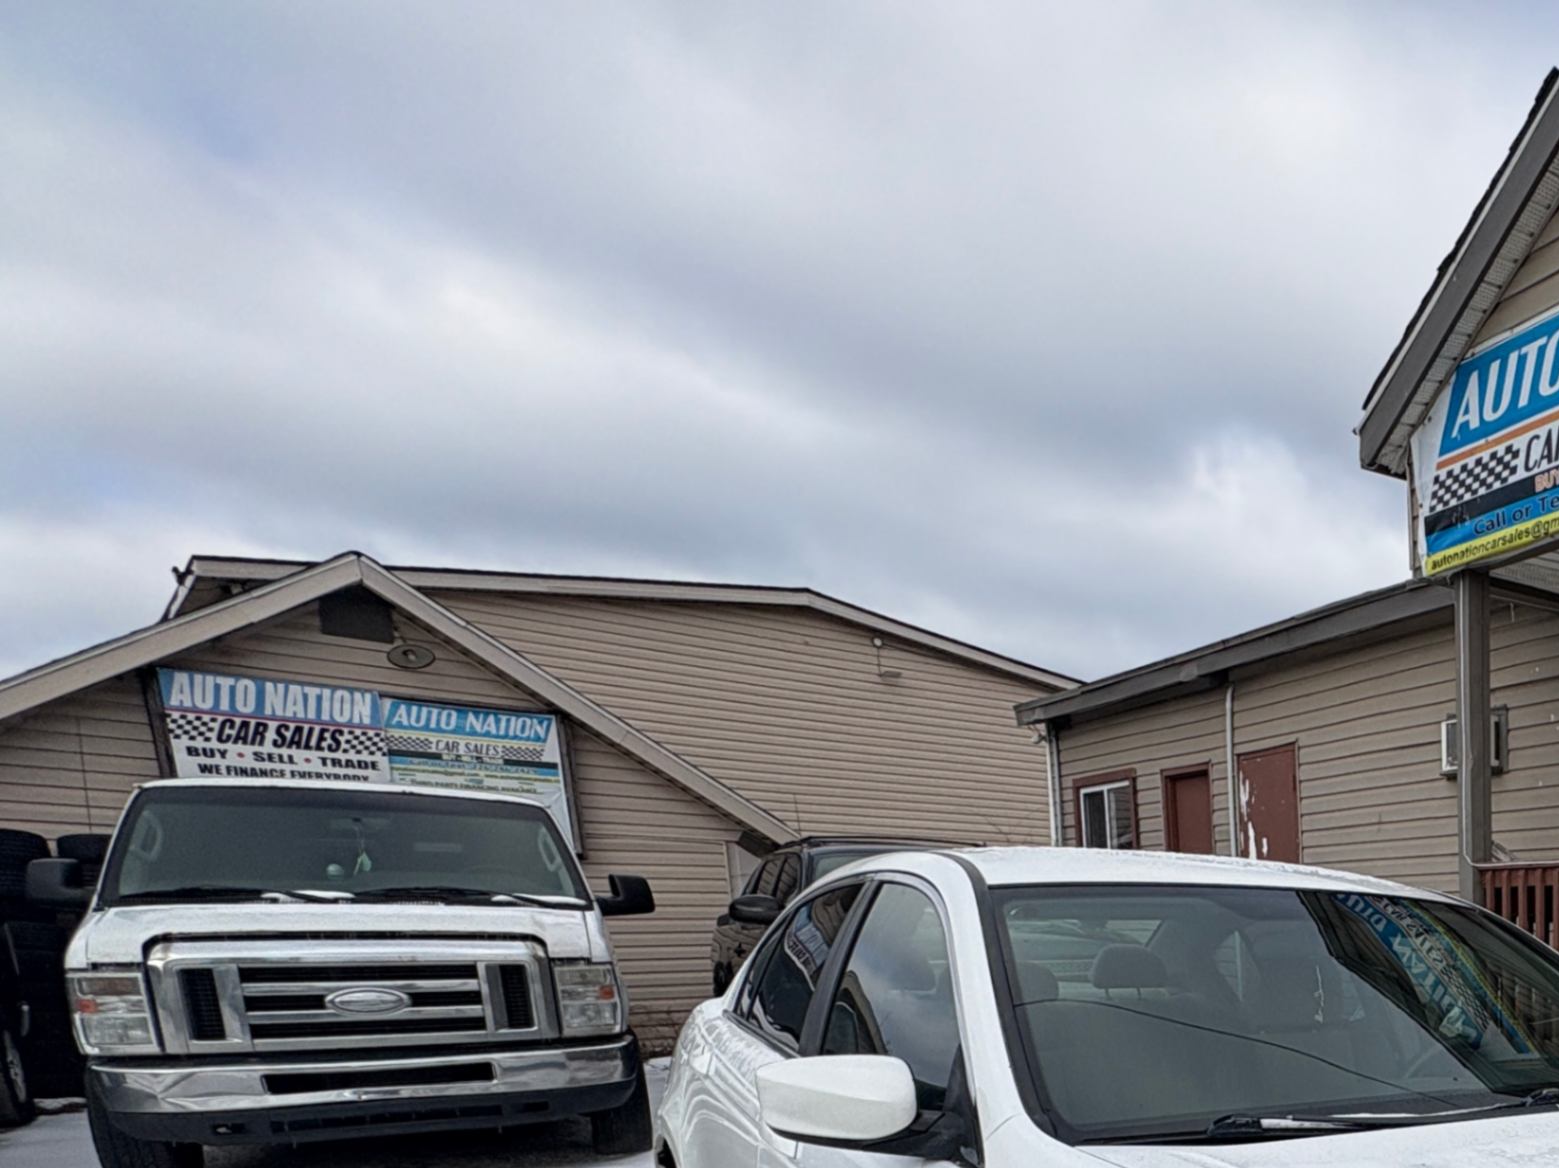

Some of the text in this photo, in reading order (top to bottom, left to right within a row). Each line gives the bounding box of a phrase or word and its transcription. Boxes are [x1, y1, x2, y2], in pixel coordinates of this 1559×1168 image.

[1473, 512, 1507, 536] Call
[1512, 505, 1531, 523] or
[169, 672, 372, 724] AUTO NATION
[216, 717, 346, 753] CAR SALES
[391, 703, 549, 740] AUTO NATION
[185, 745, 381, 771] BUY SELL TRADE
[435, 739, 500, 757] CAR SALES
[198, 763, 370, 782] WE FINANCE EVERYBODY
